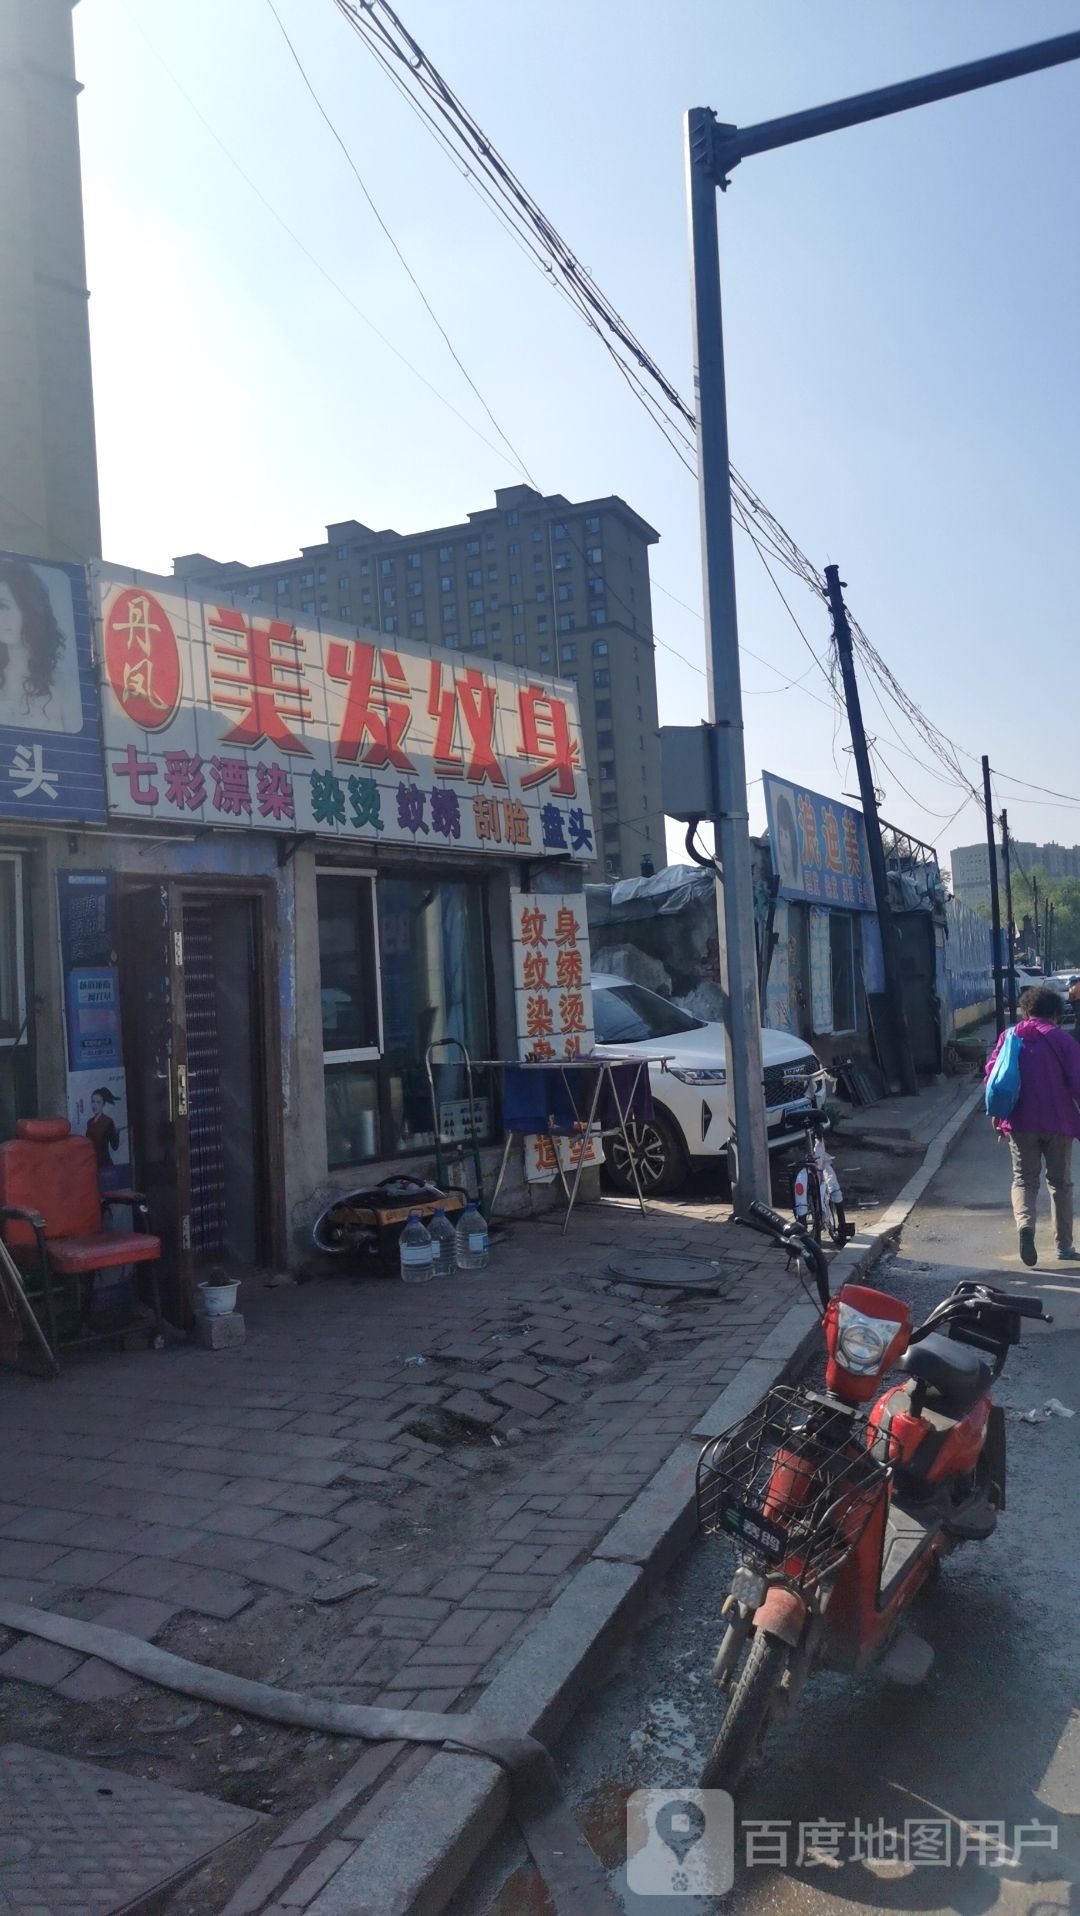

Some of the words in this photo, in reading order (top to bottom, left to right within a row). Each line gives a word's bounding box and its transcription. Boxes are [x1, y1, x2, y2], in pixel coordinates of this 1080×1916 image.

[112, 596, 168, 710] 丹凤
[207, 606, 581, 799] 美发纹身
[8, 744, 60, 800] 头
[111, 744, 295, 821] 七彩漂染
[310, 768, 384, 831] 染烫
[396, 781, 461, 839] 纹绣
[472, 794, 531, 845] 刮脸
[540, 802, 593, 851] 盘头
[520, 906, 580, 949] 纹身
[522, 950, 583, 992] 纹绣
[526, 994, 587, 1036] 染烫
